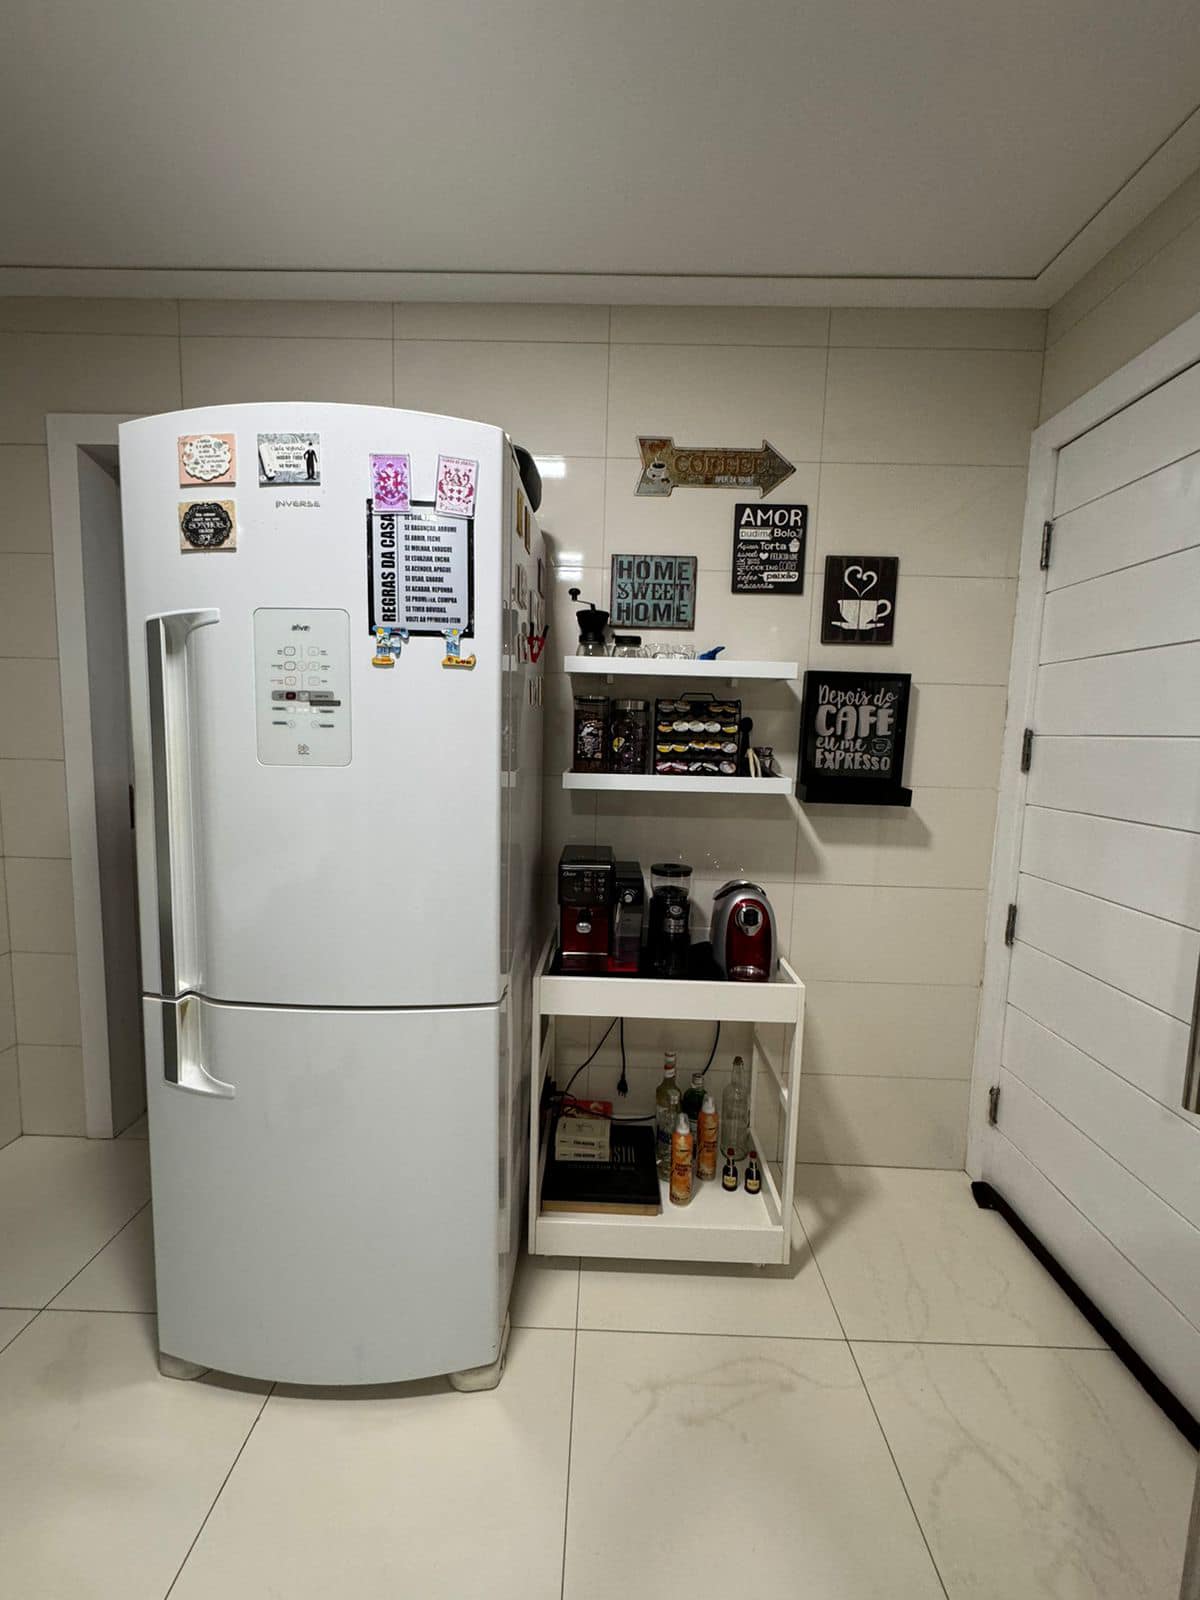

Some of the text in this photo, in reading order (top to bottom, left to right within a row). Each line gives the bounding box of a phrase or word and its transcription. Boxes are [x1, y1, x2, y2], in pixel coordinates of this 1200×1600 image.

[275, 500, 321, 508] INVERSE
[740, 507, 802, 527] AMOR
[740, 528, 797, 539] pudim Bolo
[760, 541, 788, 550] Torta
[380, 514, 397, 622] REGRAS DA CASA
[618, 559, 691, 581] HOME
[616, 582, 692, 601] SWEET
[616, 602, 690, 622] HOME
[818, 684, 898, 709] Depois do
[815, 703, 894, 740] CAFÉ
[816, 736, 867, 752] eu me
[815, 748, 891, 771] EXPRESSO
